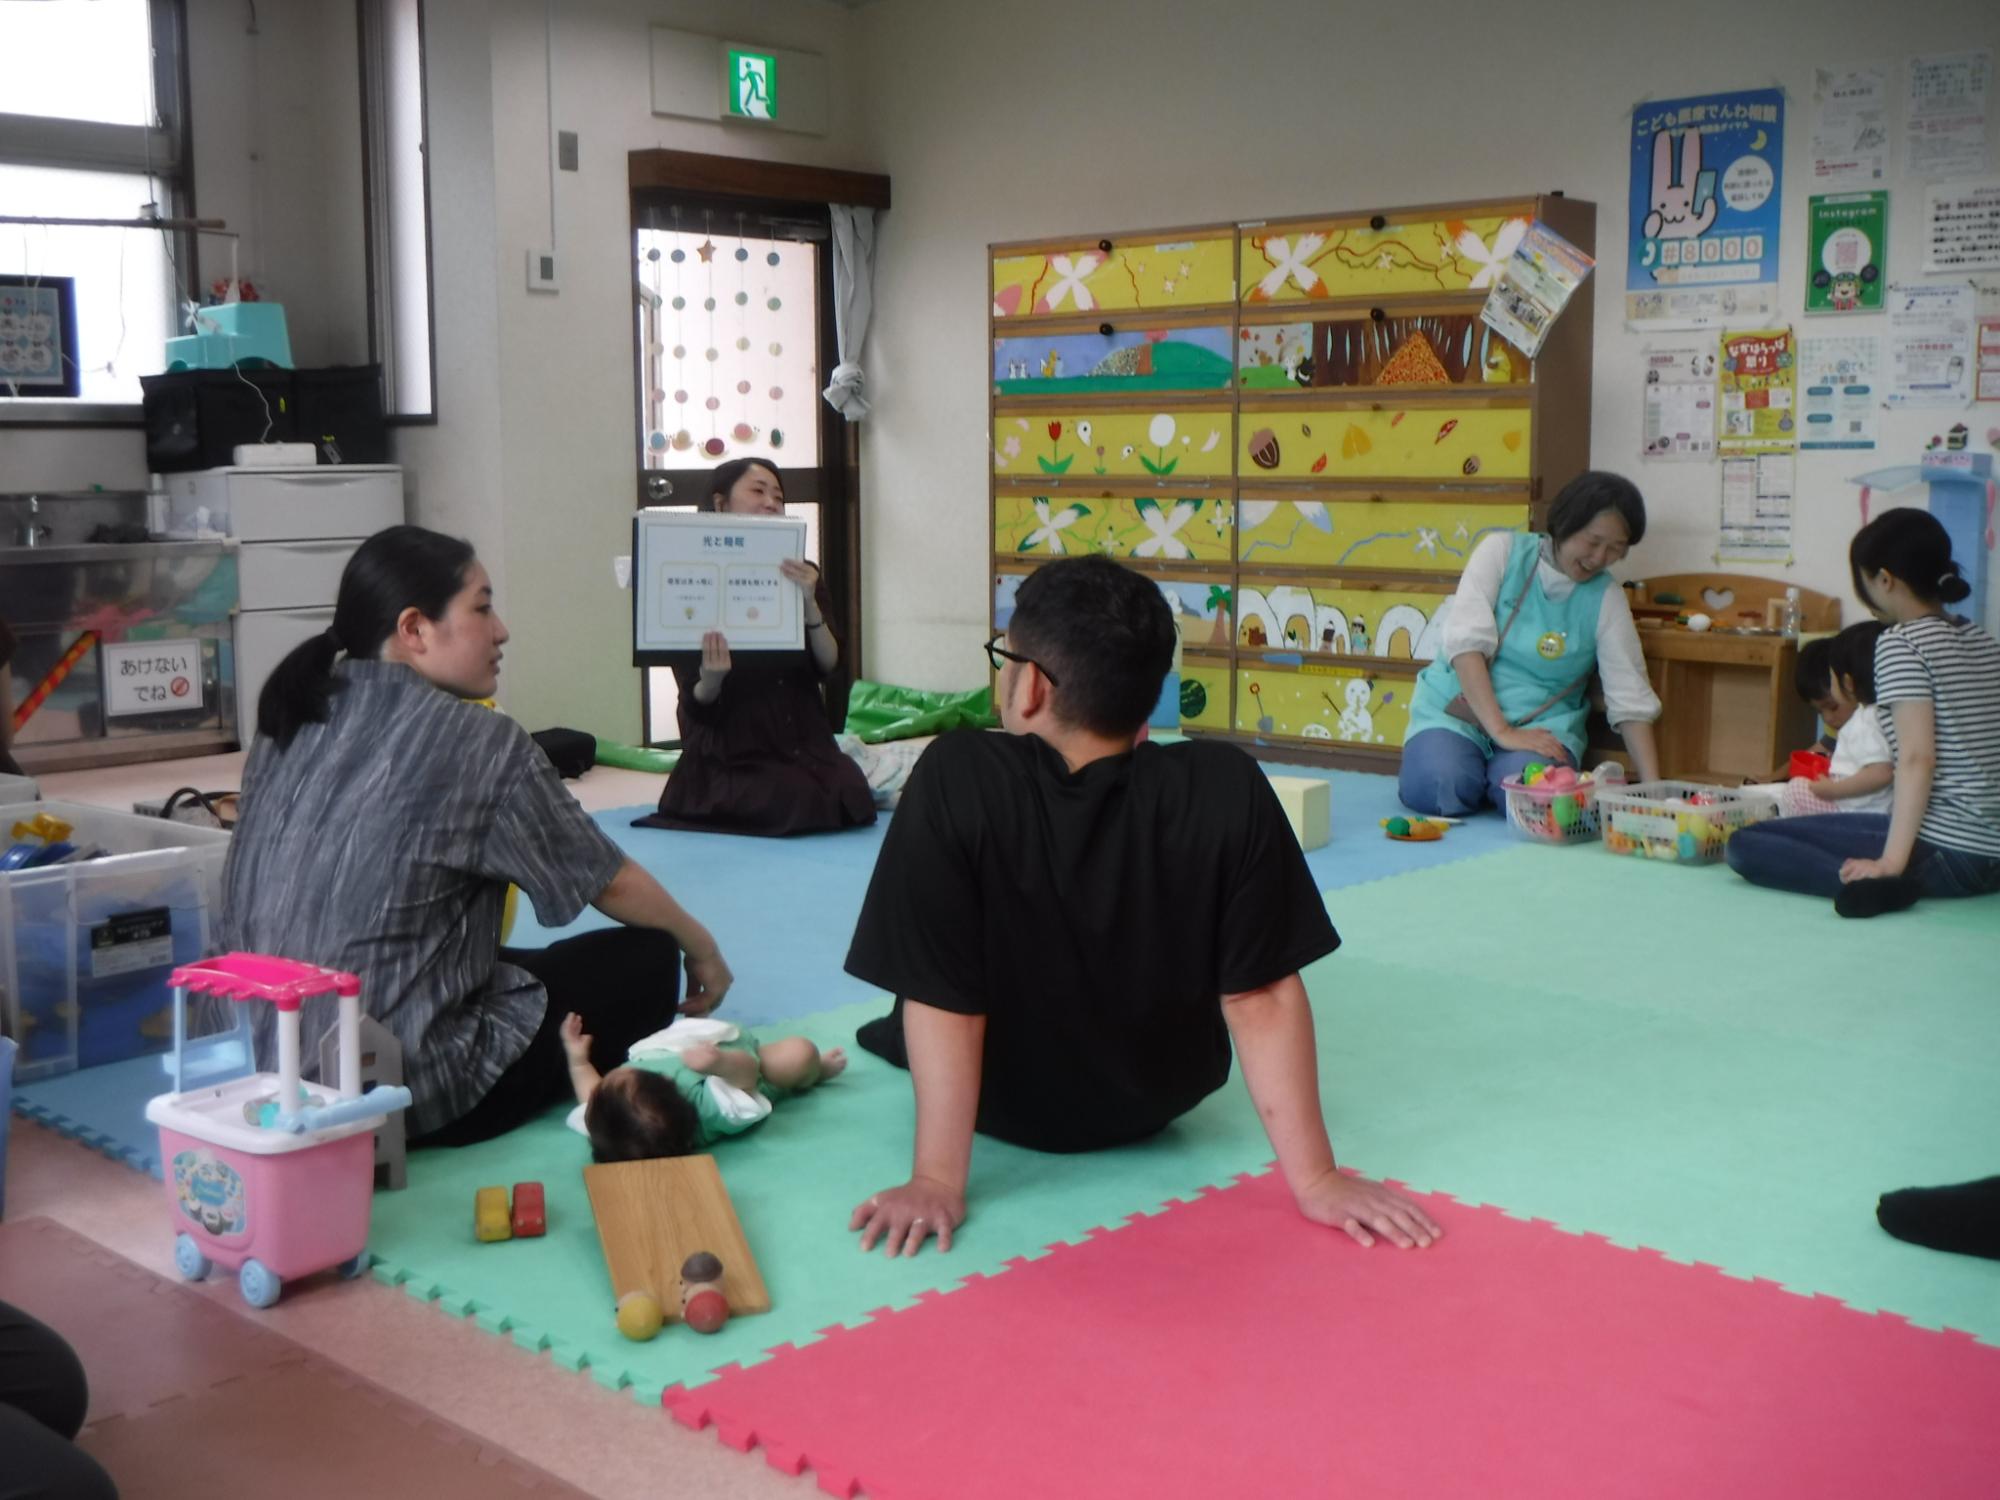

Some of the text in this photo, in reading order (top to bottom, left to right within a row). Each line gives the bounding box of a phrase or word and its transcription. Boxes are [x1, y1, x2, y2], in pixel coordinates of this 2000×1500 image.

[1819, 207, 1877, 219] Instagram
[1663, 239, 1760, 262] #8000
[120, 657, 188, 676] あけない
[133, 685, 167, 702] でね
